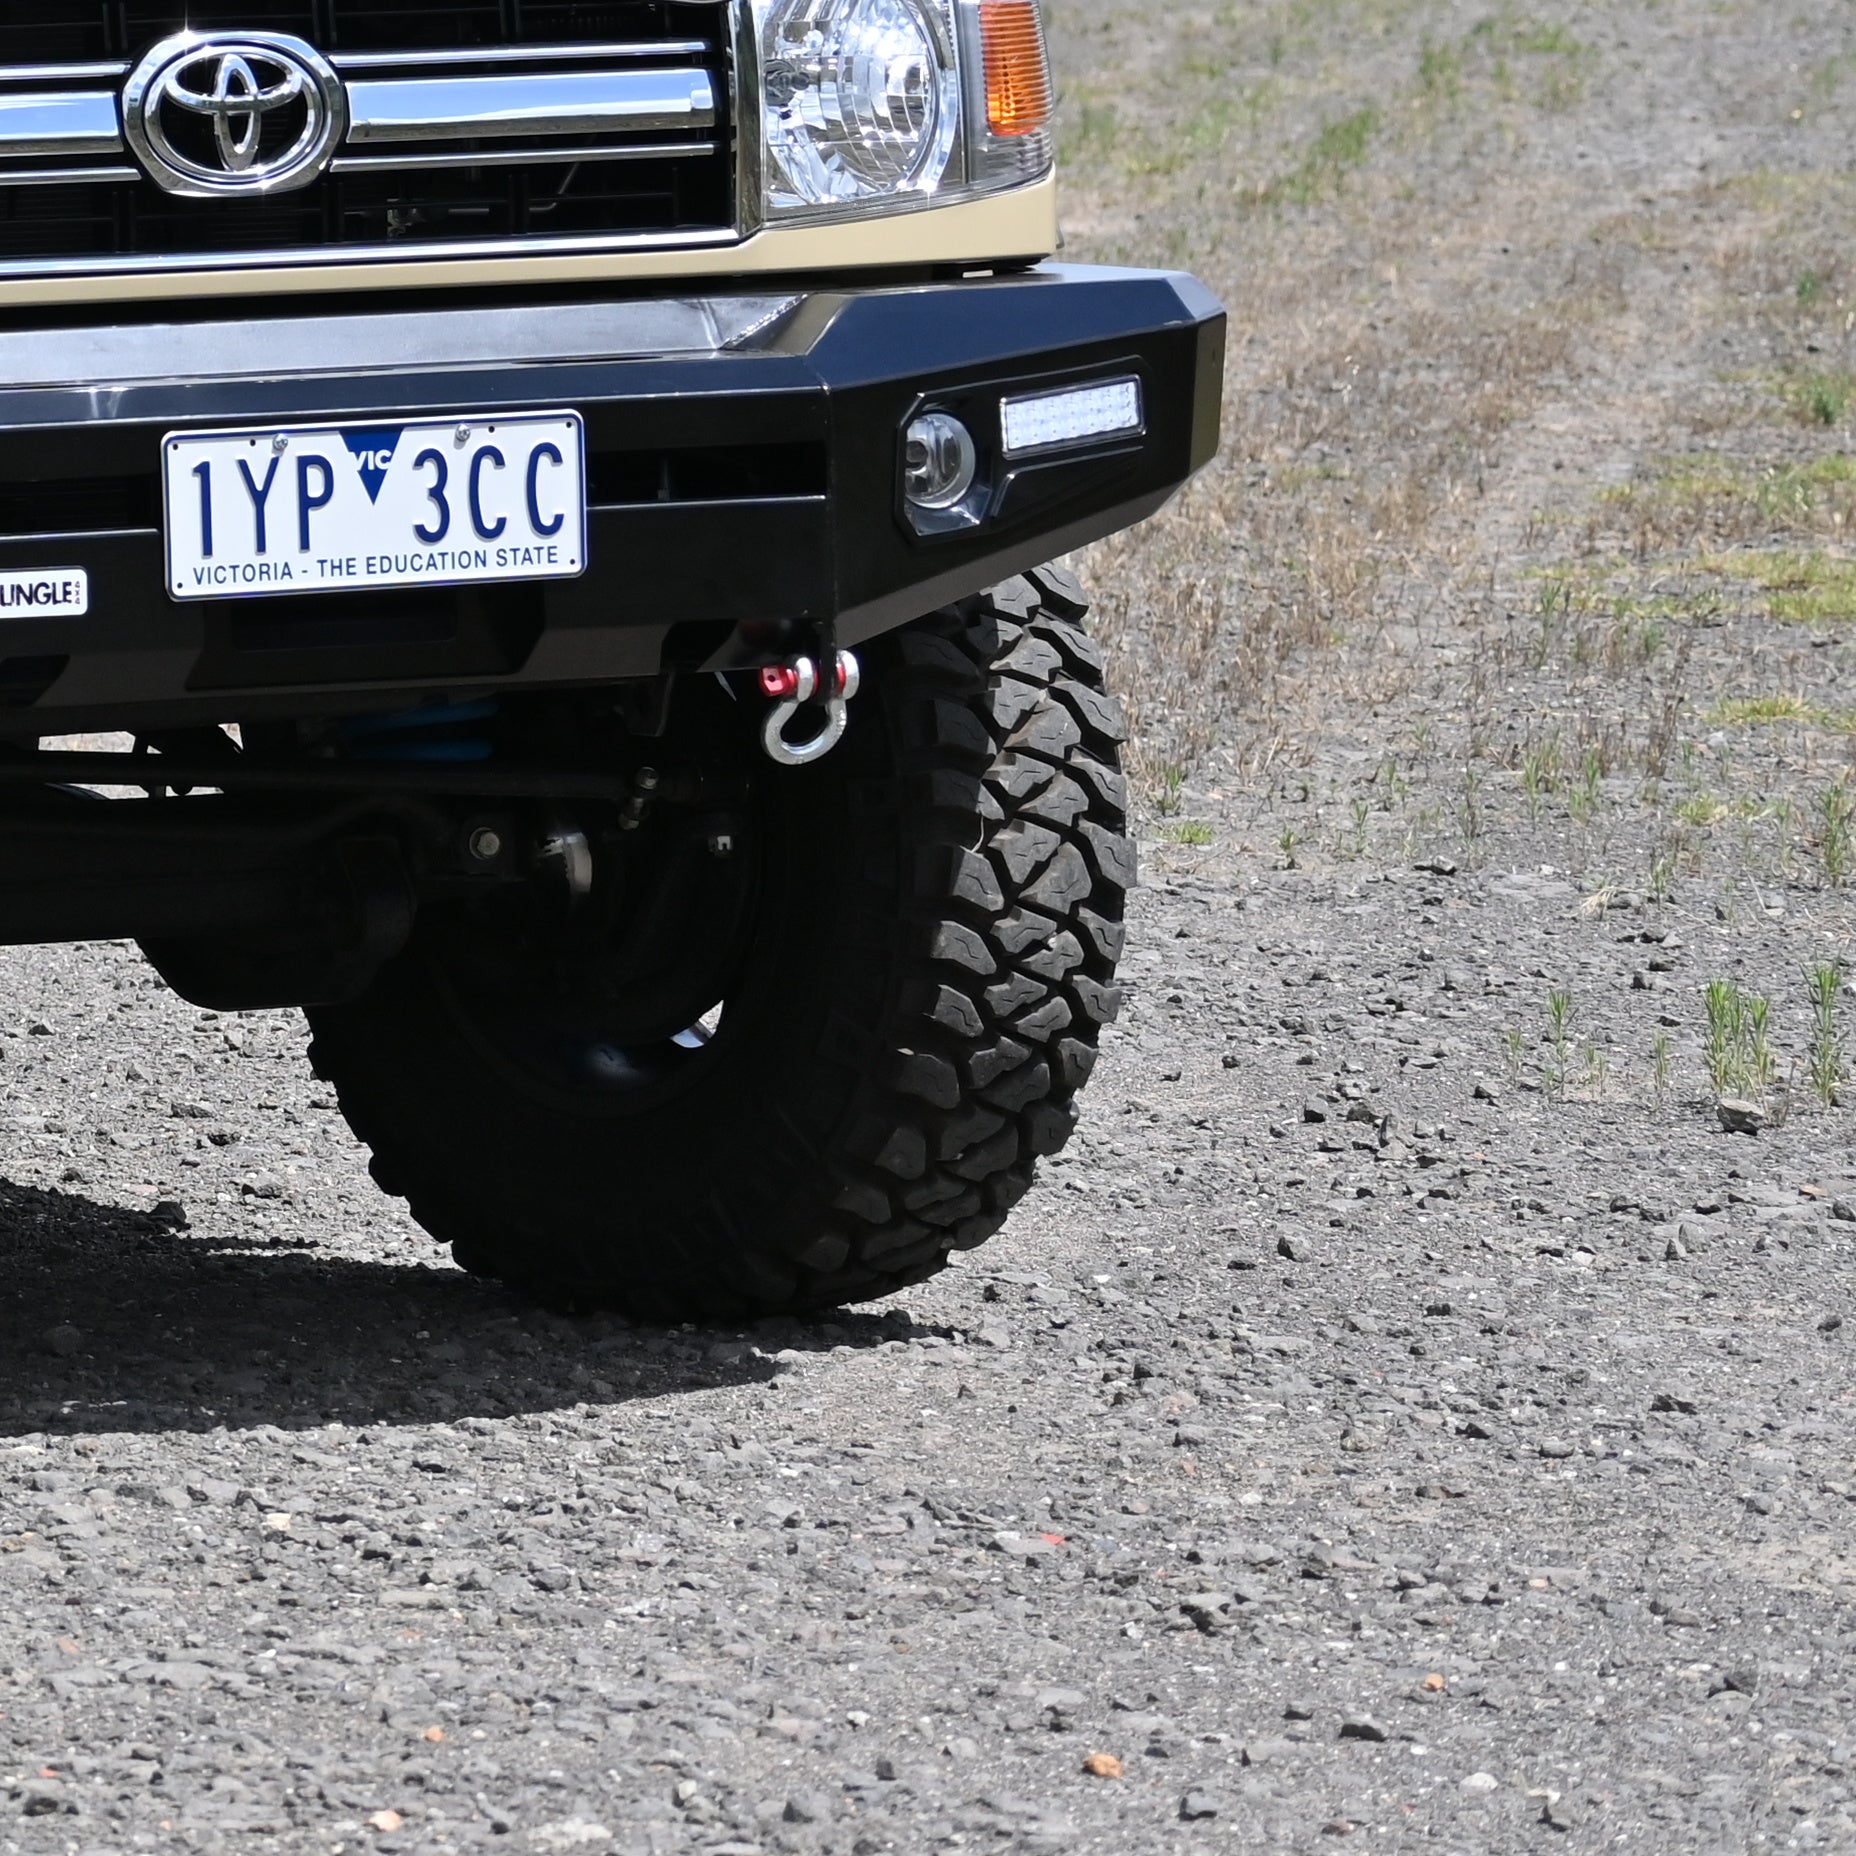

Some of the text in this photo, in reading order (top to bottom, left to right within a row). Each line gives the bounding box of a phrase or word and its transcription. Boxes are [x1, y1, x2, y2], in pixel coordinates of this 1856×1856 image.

[349, 449, 392, 471] VIC
[192, 442, 565, 556] 1YP 3CC
[193, 561, 293, 586] VICTORIA
[317, 557, 357, 578] THE
[366, 550, 488, 575] EDUCATION
[496, 545, 559, 567] STATE
